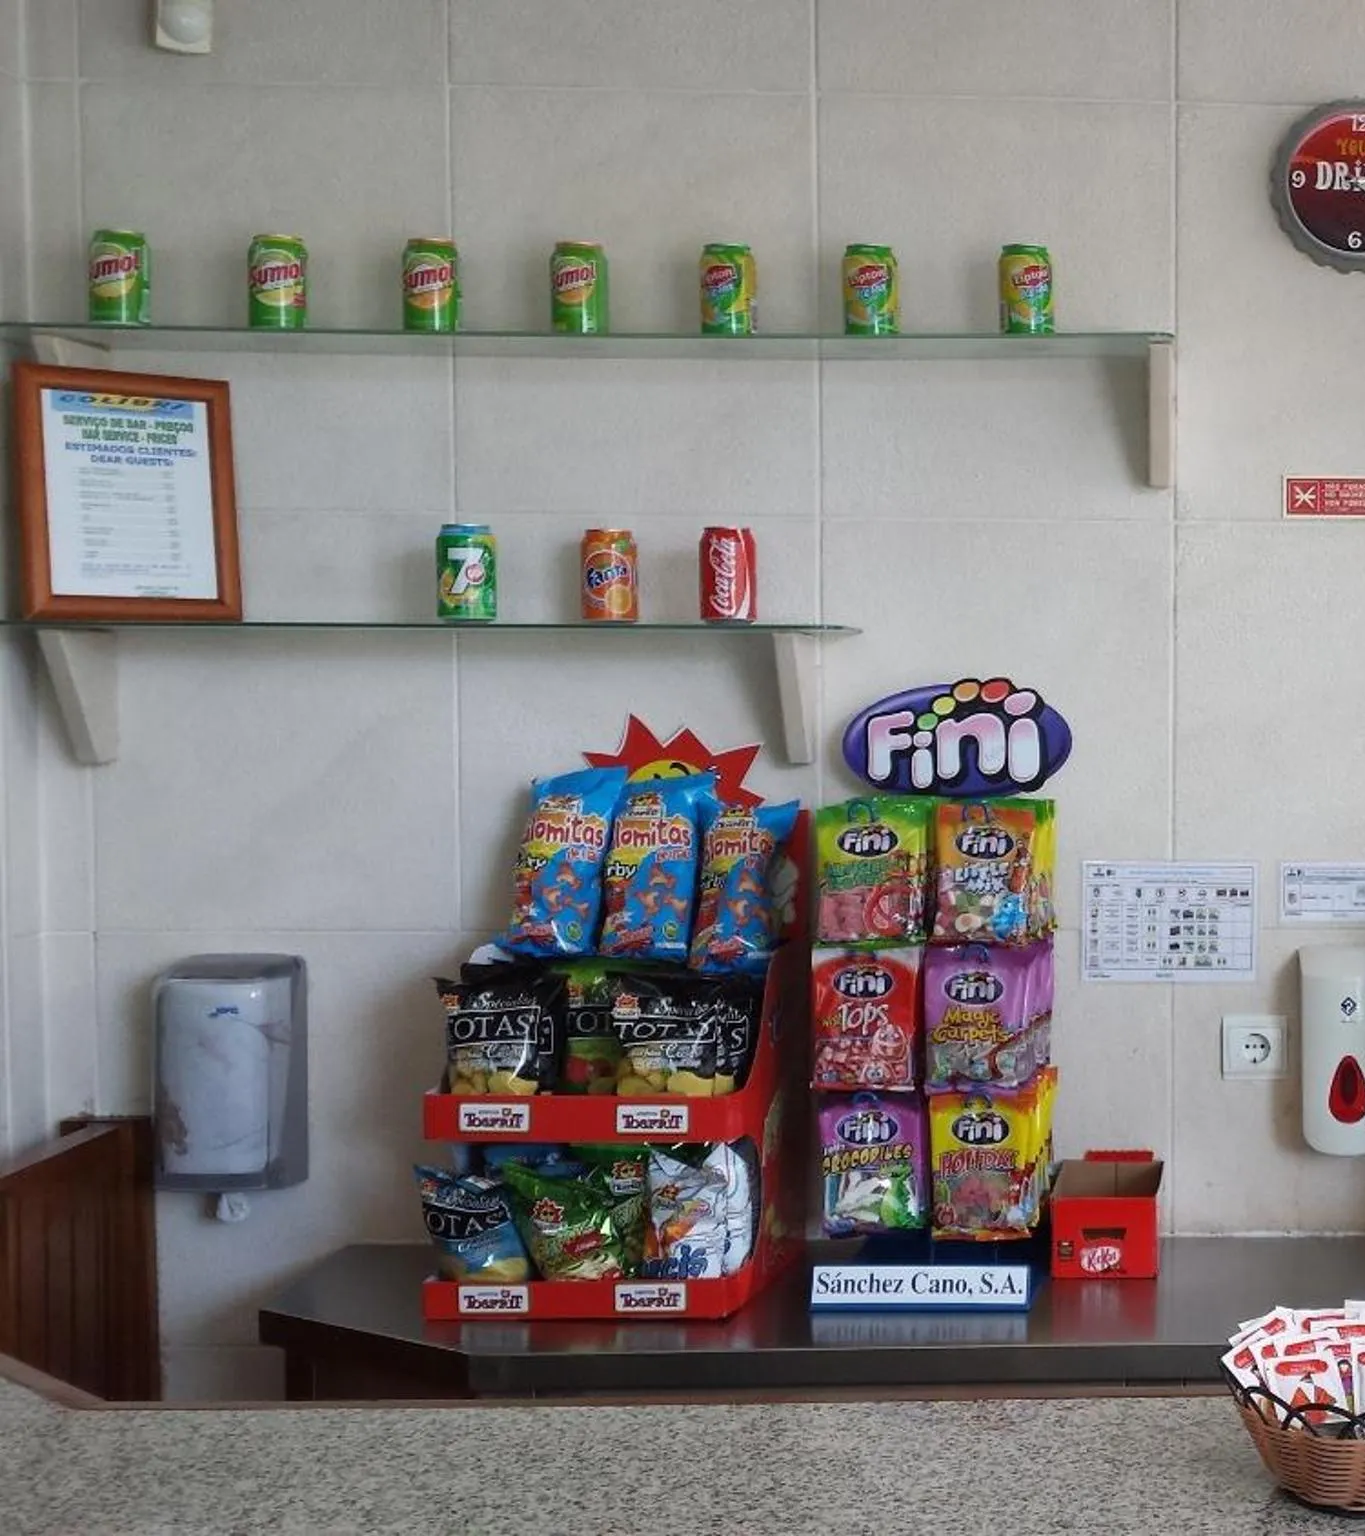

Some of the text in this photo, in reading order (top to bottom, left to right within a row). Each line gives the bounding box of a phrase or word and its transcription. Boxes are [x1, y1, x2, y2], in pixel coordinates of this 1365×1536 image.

[1292, 170, 1306, 188] 9
[1348, 231, 1362, 248] 6
[867, 690, 1040, 789] Fini
[843, 827, 891, 853] Fini
[961, 831, 1007, 856] Fini
[839, 969, 886, 995] Fini
[949, 974, 996, 1002] Fini
[449, 1014, 534, 1040] OTAS
[957, 1116, 1003, 1142] Fini
[426, 1210, 505, 1237] OTAS
[815, 1270, 1024, 1298] Sánchez Cano, S.A.
